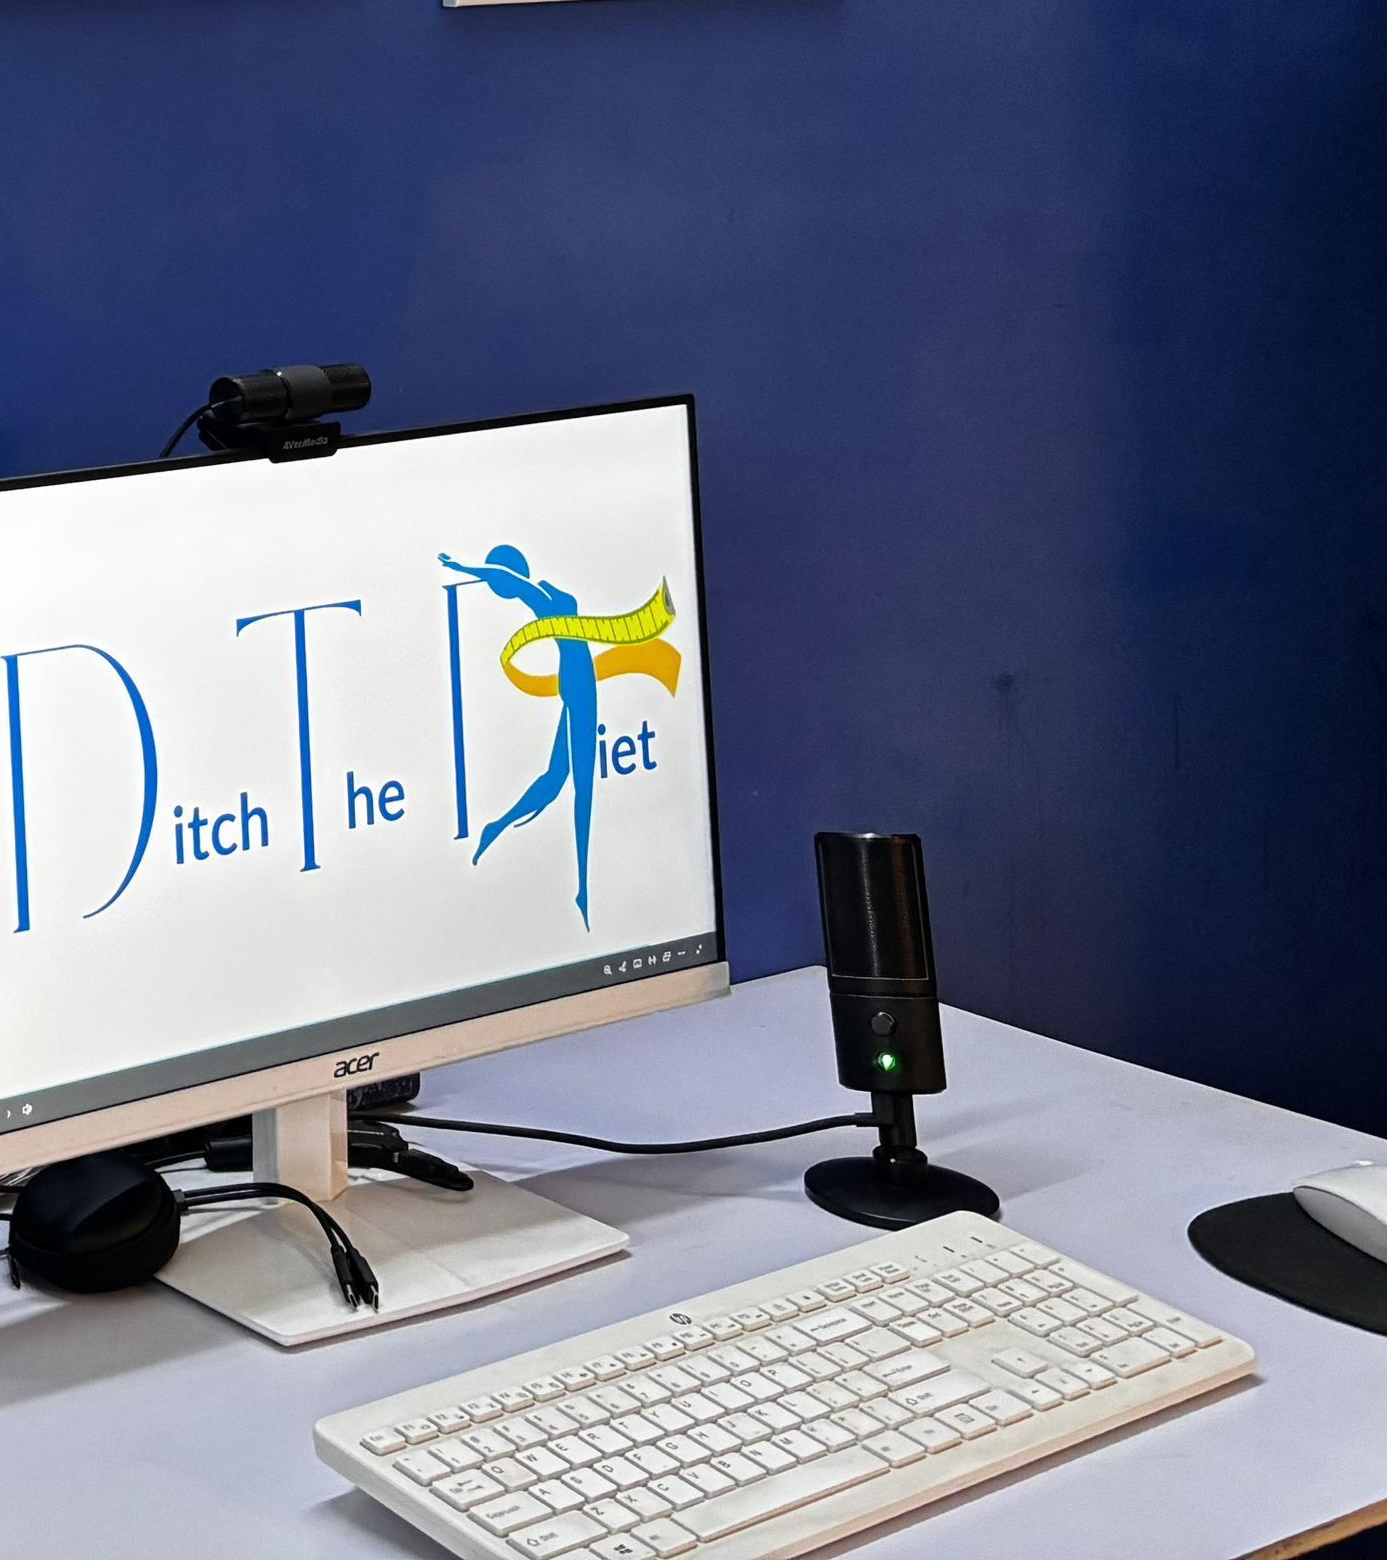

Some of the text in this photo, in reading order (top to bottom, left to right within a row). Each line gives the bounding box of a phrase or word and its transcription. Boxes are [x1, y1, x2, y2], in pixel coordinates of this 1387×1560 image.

[0, 642, 270, 934] Ditch
[235, 598, 406, 873] The
[333, 1050, 380, 1078] acer
